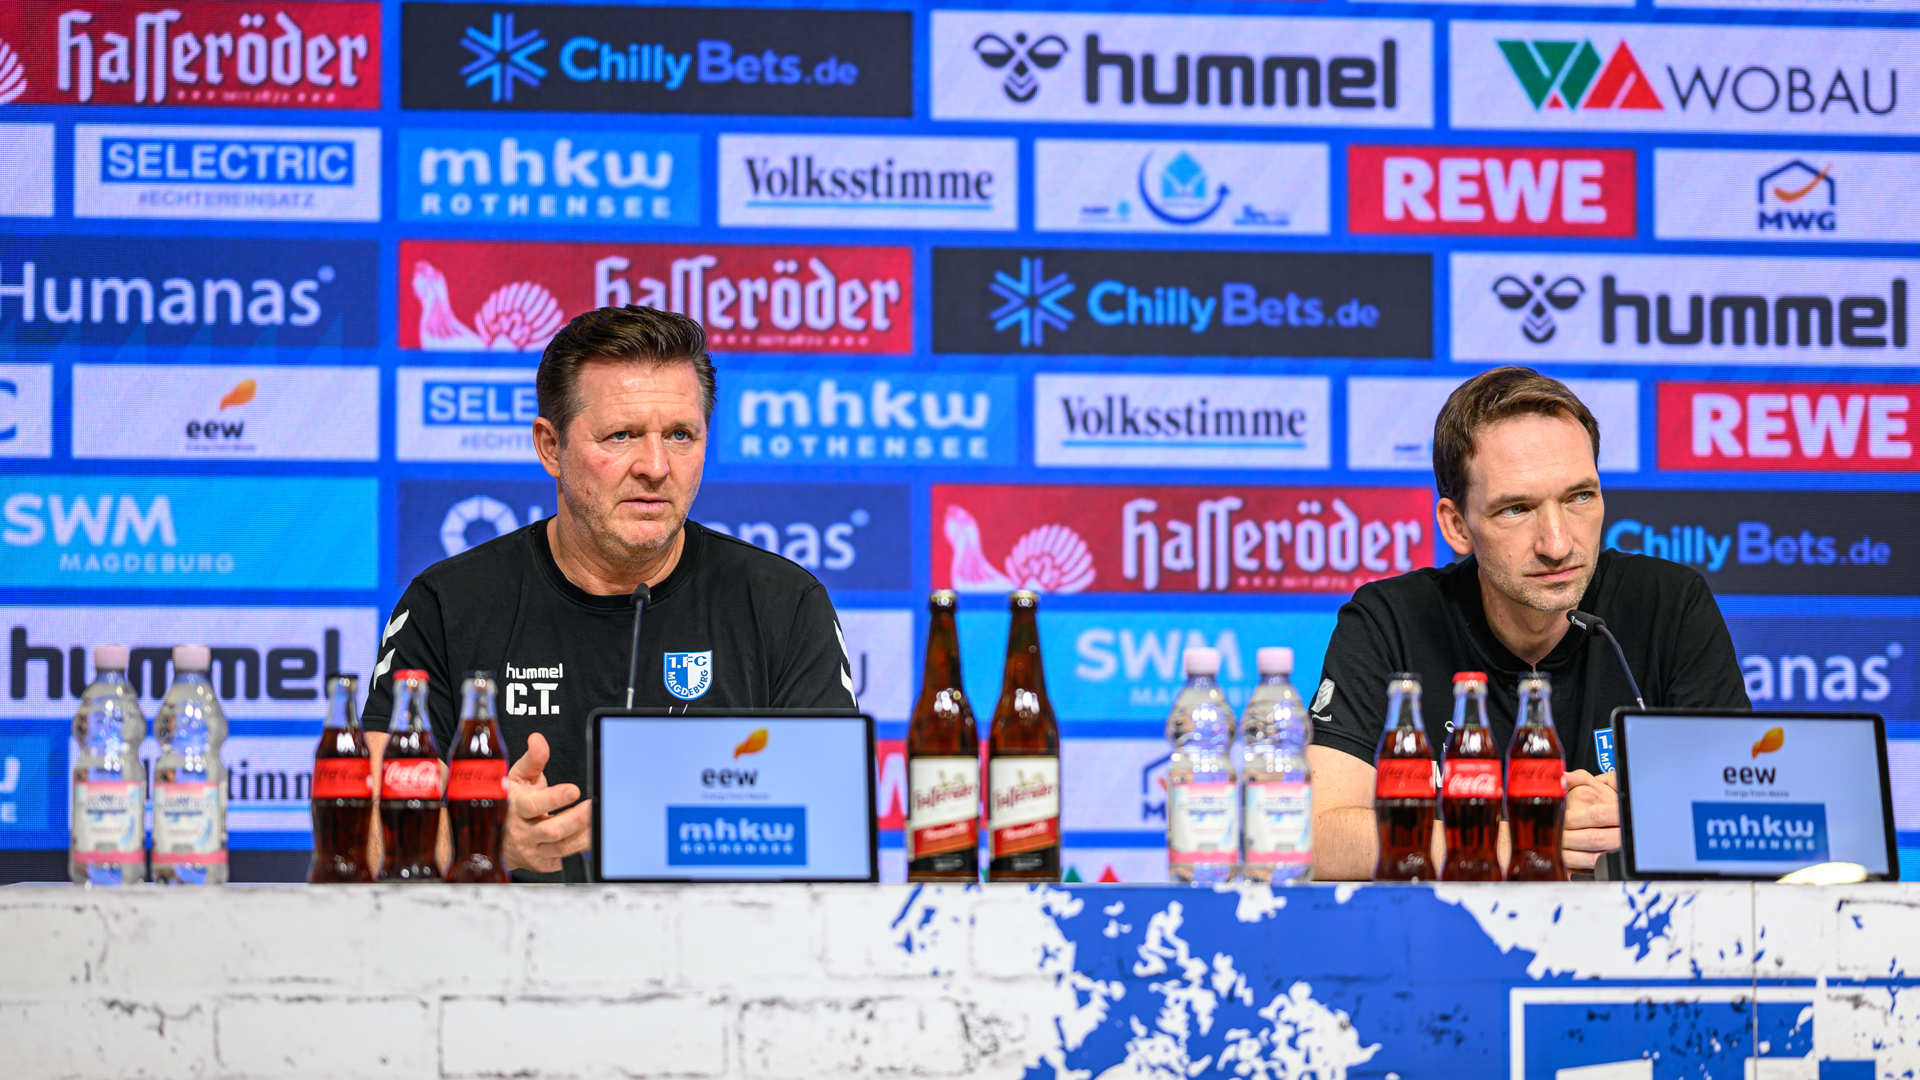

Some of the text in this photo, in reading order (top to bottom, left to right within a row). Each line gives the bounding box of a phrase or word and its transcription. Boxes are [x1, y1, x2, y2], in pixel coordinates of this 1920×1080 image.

[1085, 33, 1397, 109] hummel
[1667, 65, 1898, 115] WOBAU
[107, 142, 349, 181] SELECTRIC
[420, 139, 673, 189] mhkw
[745, 156, 994, 200] Volksstimme
[1383, 156, 1607, 224] REWE
[138, 190, 315, 209] #ECHTEREINSATZ
[421, 193, 671, 217] ROTHENSEE
[1758, 212, 1836, 231] MWG
[1602, 275, 1907, 348] hummel
[740, 379, 990, 429] mhkw
[1061, 397, 1307, 438] Volksstimme
[186, 420, 244, 440] eew
[1691, 393, 1912, 459] REWE
[741, 434, 988, 459] ROTHENSEE
[3, 494, 178, 547] SWM
[59, 552, 236, 574] MAGDEBURG
[506, 662, 563, 679] hummel
[667, 669, 709, 697] MAGDEBURG
[1741, 655, 1892, 701] anas
[506, 683, 560, 715] C.T.
[701, 768, 758, 787] eew
[1723, 766, 1776, 784] eew
[680, 817, 795, 841] mhkw
[1706, 814, 1814, 837] mhkw
